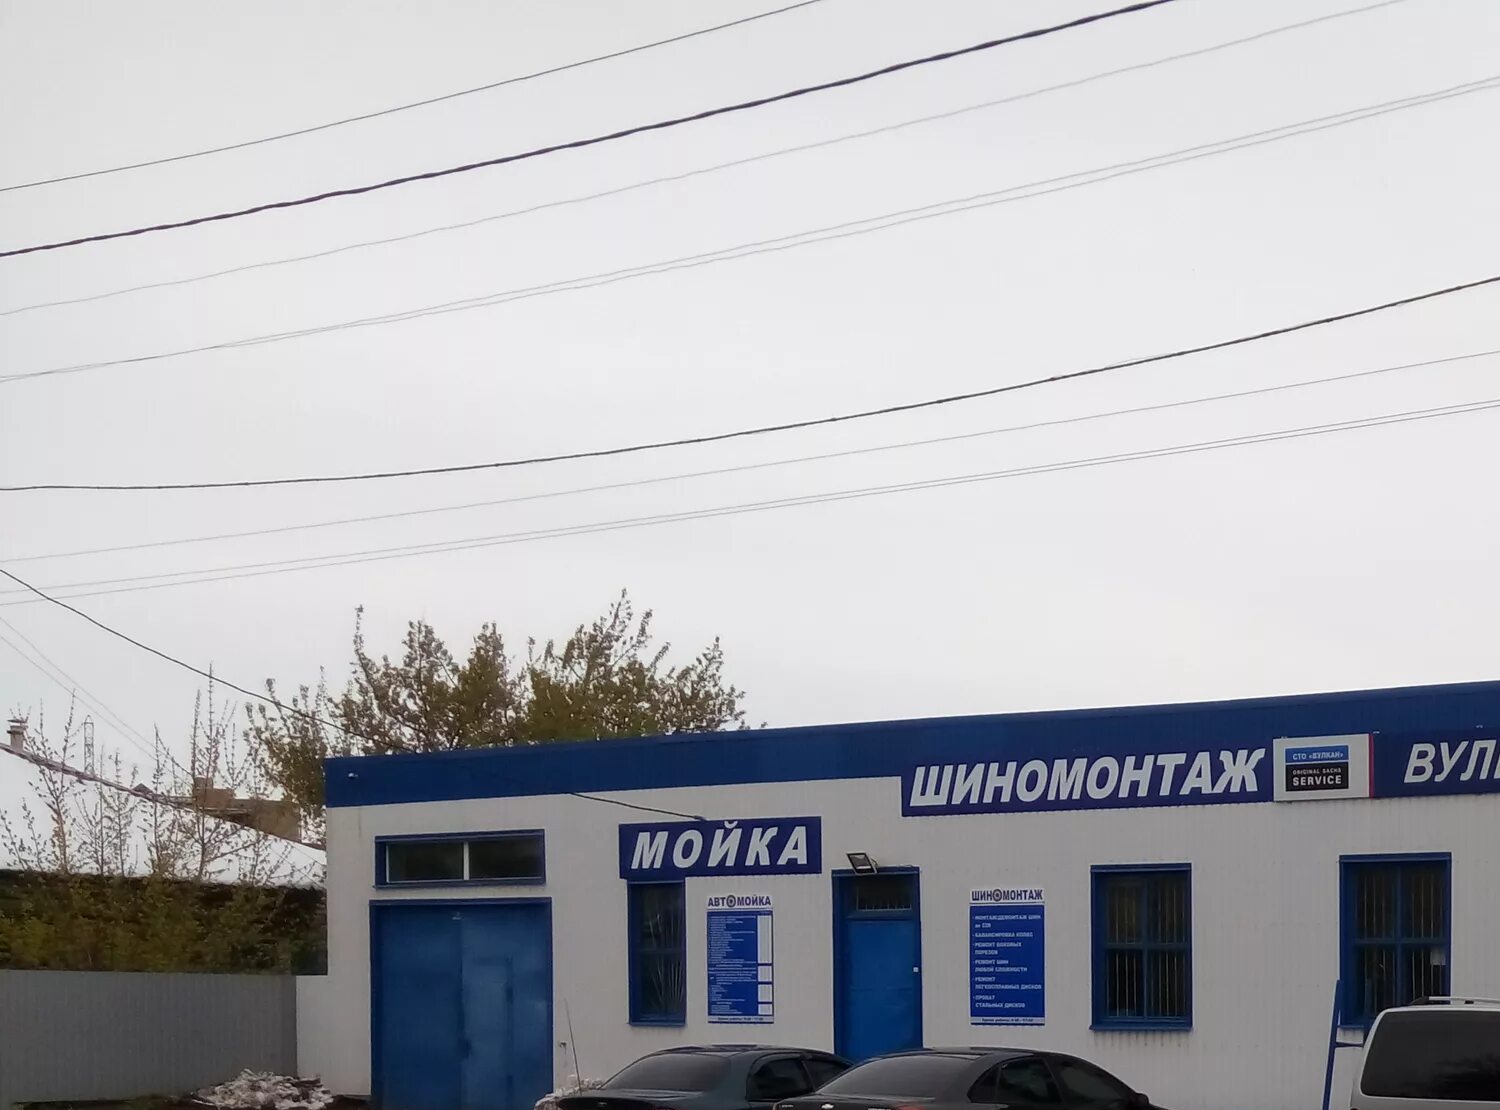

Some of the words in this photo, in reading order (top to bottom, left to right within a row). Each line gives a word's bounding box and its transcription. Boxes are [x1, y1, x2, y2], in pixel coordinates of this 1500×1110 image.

[1309, 751, 1344, 759] «ВУЛКАН»
[909, 748, 1266, 807] ШИНОМОНТАЖ
[1292, 775, 1342, 786] SERVICE
[630, 820, 808, 870] МОЙКА
[707, 894, 772, 908] АВТОМОЙКА
[971, 888, 1043, 901] ШИНОМОНТАЖ
